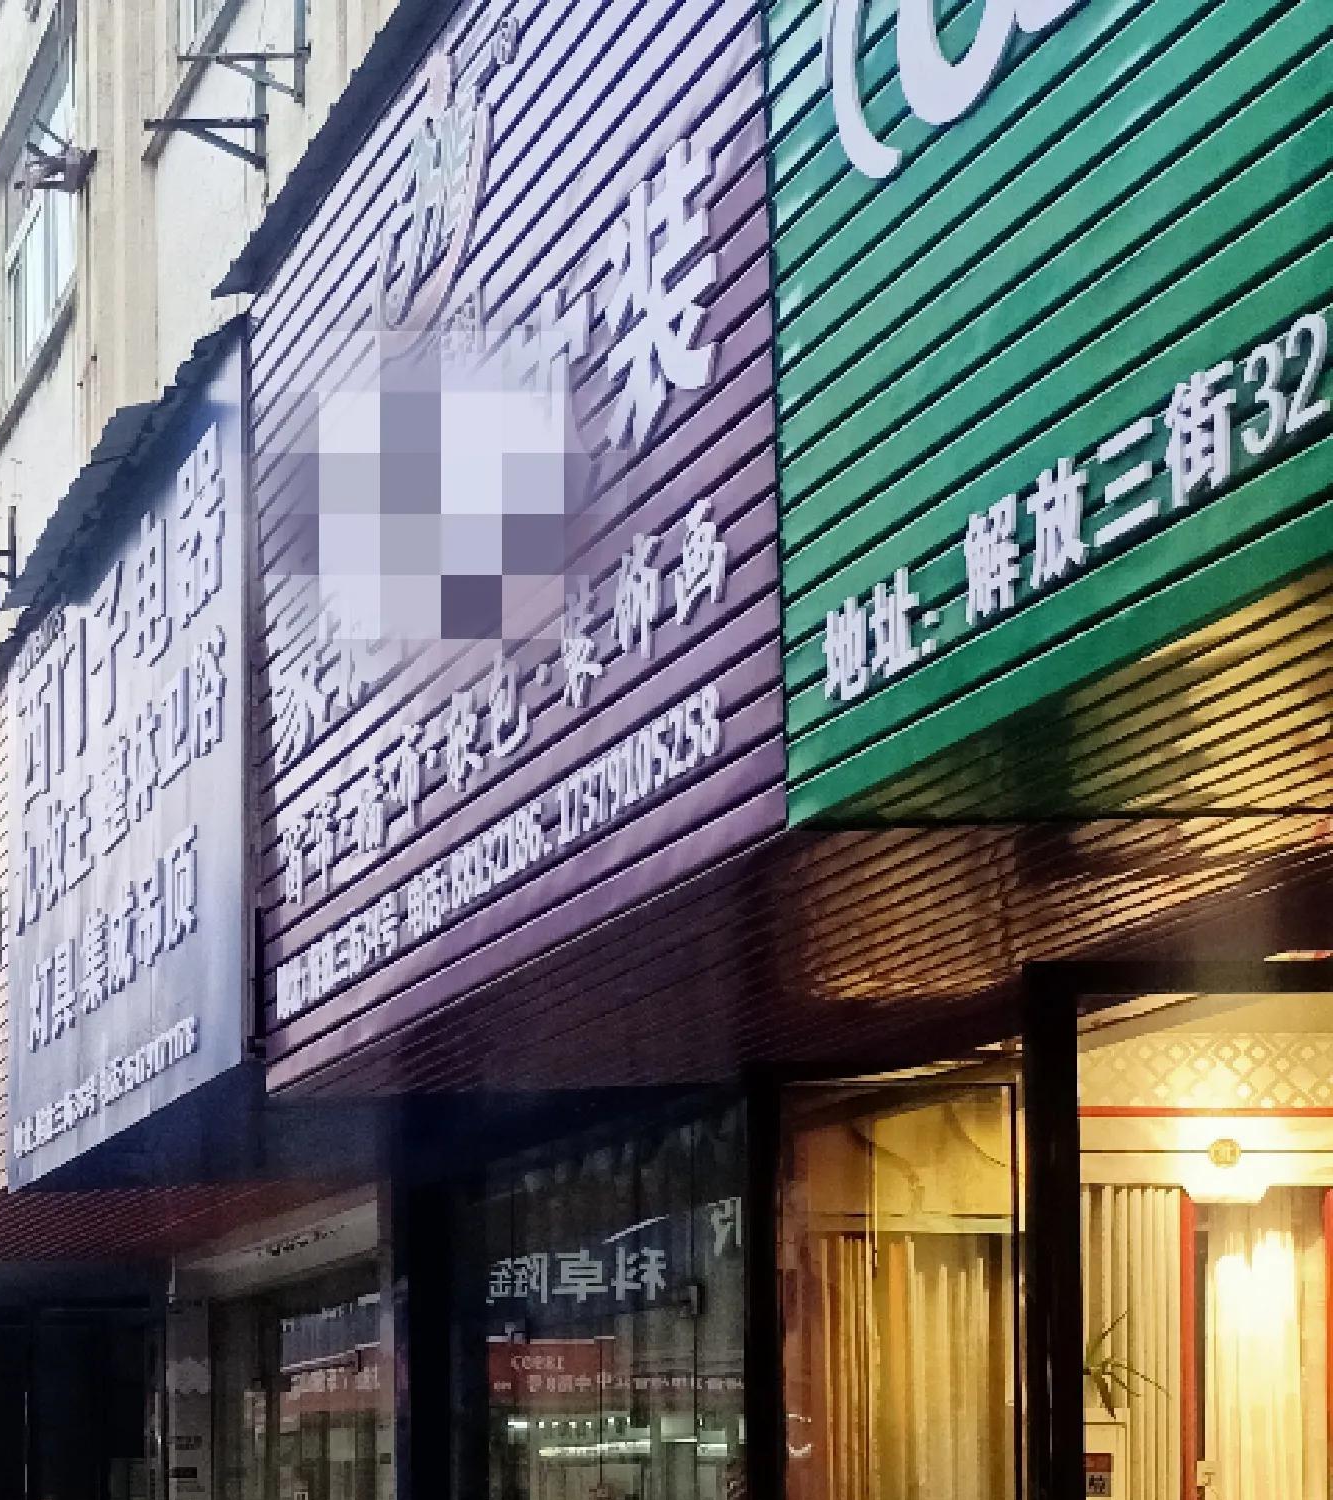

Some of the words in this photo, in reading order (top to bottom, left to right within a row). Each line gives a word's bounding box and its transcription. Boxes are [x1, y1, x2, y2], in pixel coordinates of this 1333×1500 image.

[17, 422, 225, 816] 西门子电器
